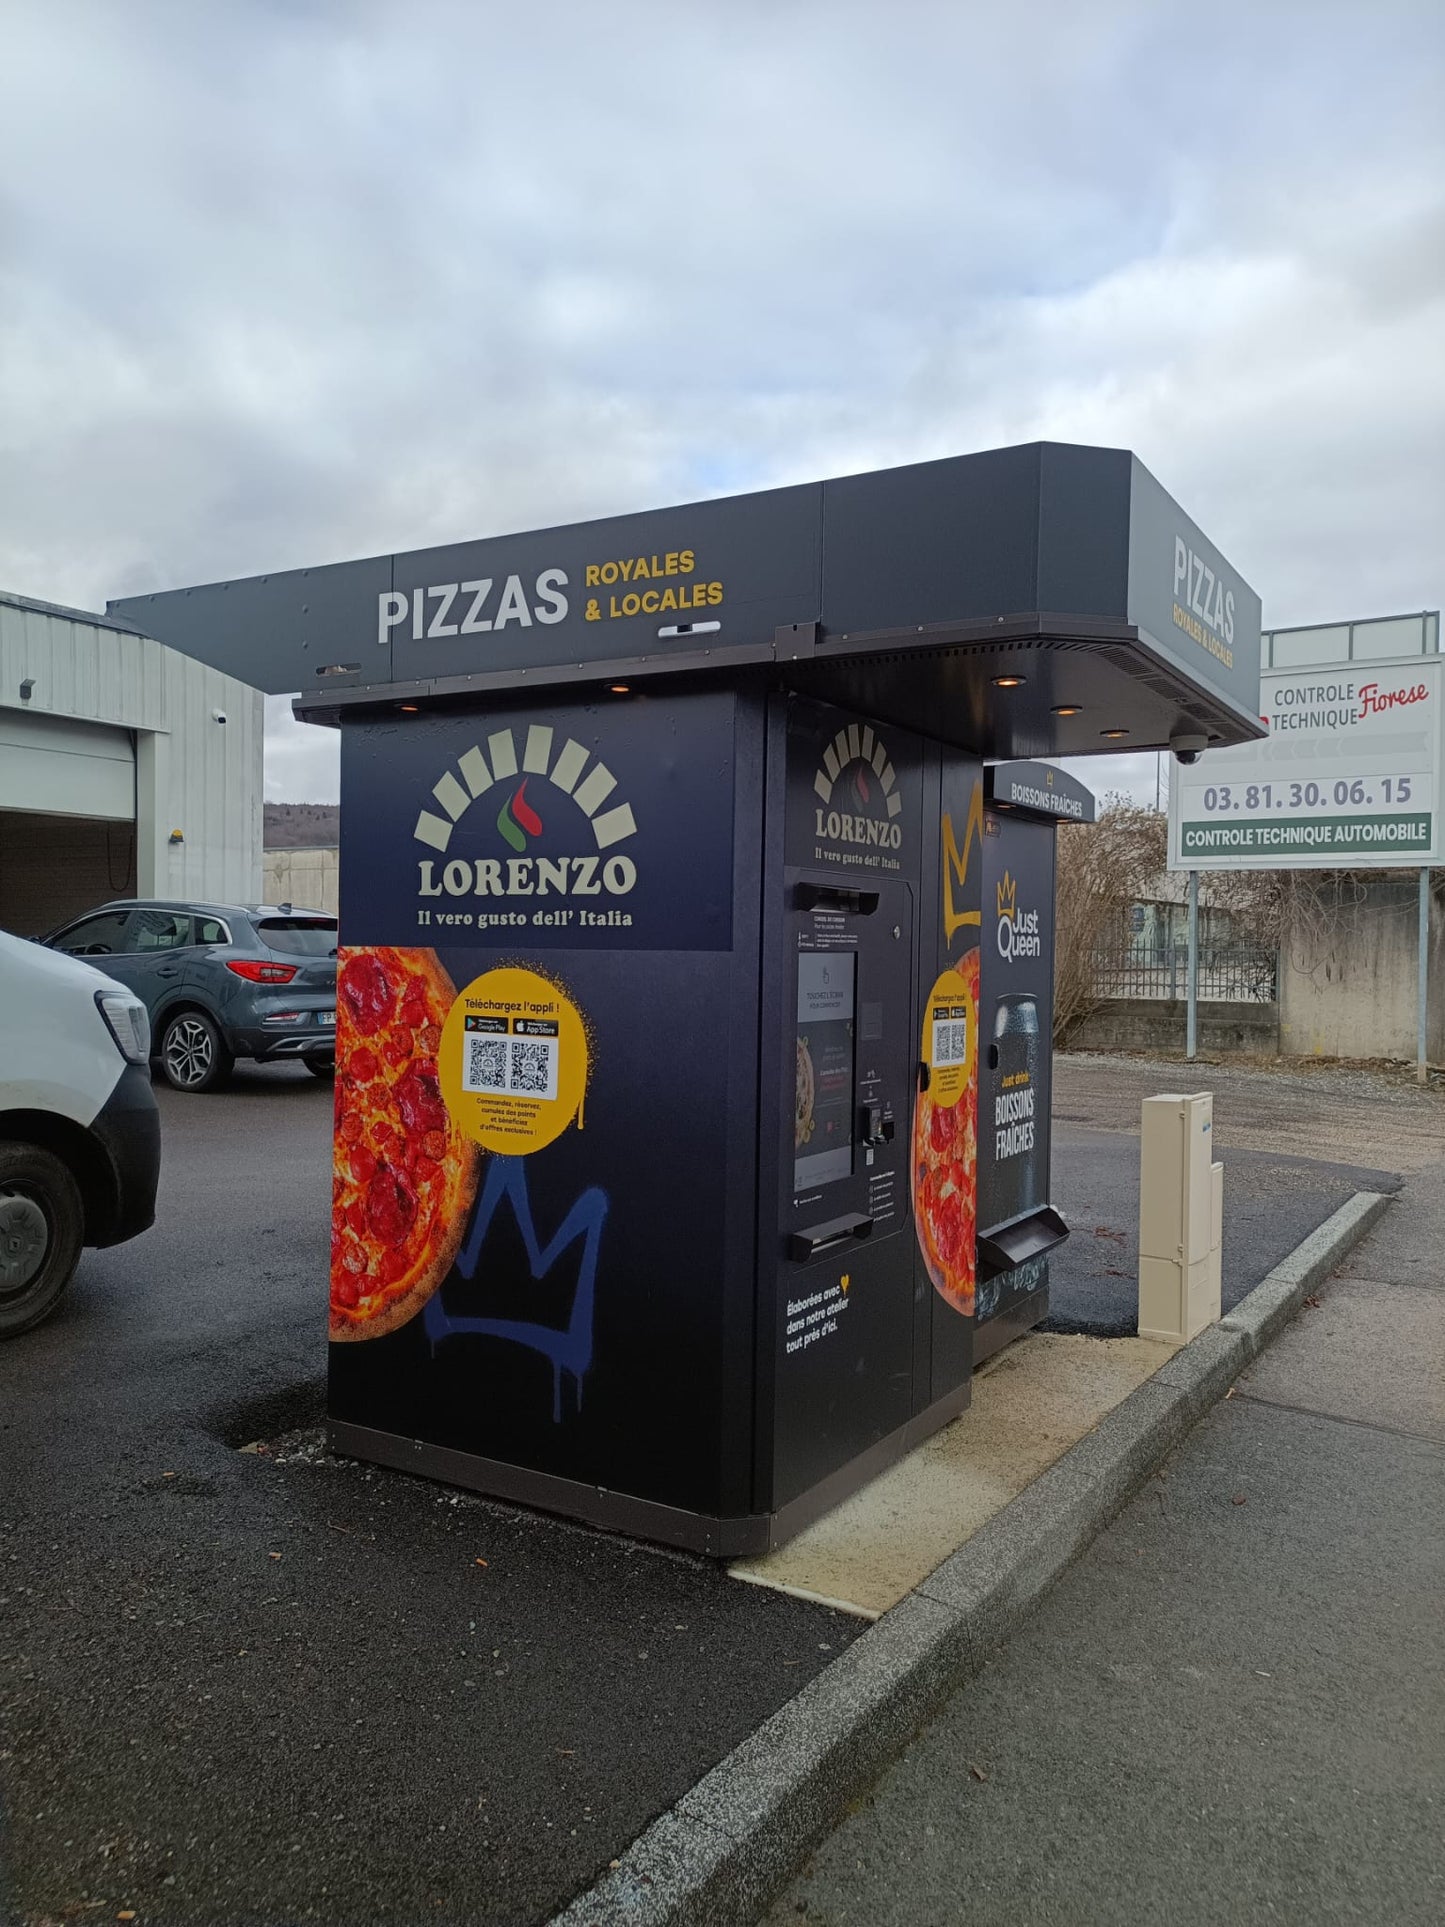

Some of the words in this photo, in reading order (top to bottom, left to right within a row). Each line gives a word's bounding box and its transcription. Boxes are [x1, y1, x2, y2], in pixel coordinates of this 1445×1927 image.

[585, 550, 695, 587] ROYALES
[378, 568, 569, 644] PIZZAS
[585, 599, 601, 622] &
[610, 581, 723, 618] LOCALES
[1174, 534, 1235, 644] PIZZAS
[1275, 683, 1354, 706] CONTROLE
[1358, 683, 1430, 719] Fiorese
[1272, 708, 1358, 731] TECHNIQUE
[1011, 783, 1050, 809] BOISSONS
[816, 808, 902, 850] LORENZO
[1186, 828, 1253, 847] CONTROLE
[1255, 826, 1332, 846] TECHNIQUE
[1334, 822, 1427, 843] AUTOMOBILE
[418, 855, 637, 896] LORENZO
[824, 851, 841, 862] vero
[842, 854, 863, 865] gusto
[881, 857, 900, 870] Italia
[418, 910, 431, 925] Il
[436, 912, 473, 925] vero
[478, 912, 527, 929] gusto
[580, 910, 632, 926] Italia
[1013, 907, 1039, 934] Just
[998, 915, 1040, 963] Queen
[465, 998, 521, 1013] Téléchargez
[526, 1026, 540, 1035] App
[995, 1087, 1035, 1127] BOISSONS
[995, 1121, 1035, 1161] FRAÎCHES
[823, 1285, 840, 1300] avec
[786, 1318, 805, 1335] dans
[806, 1309, 825, 1326] notre
[827, 1298, 849, 1316] atelier
[786, 1337, 802, 1353] tout
[804, 1328, 820, 1349] près
